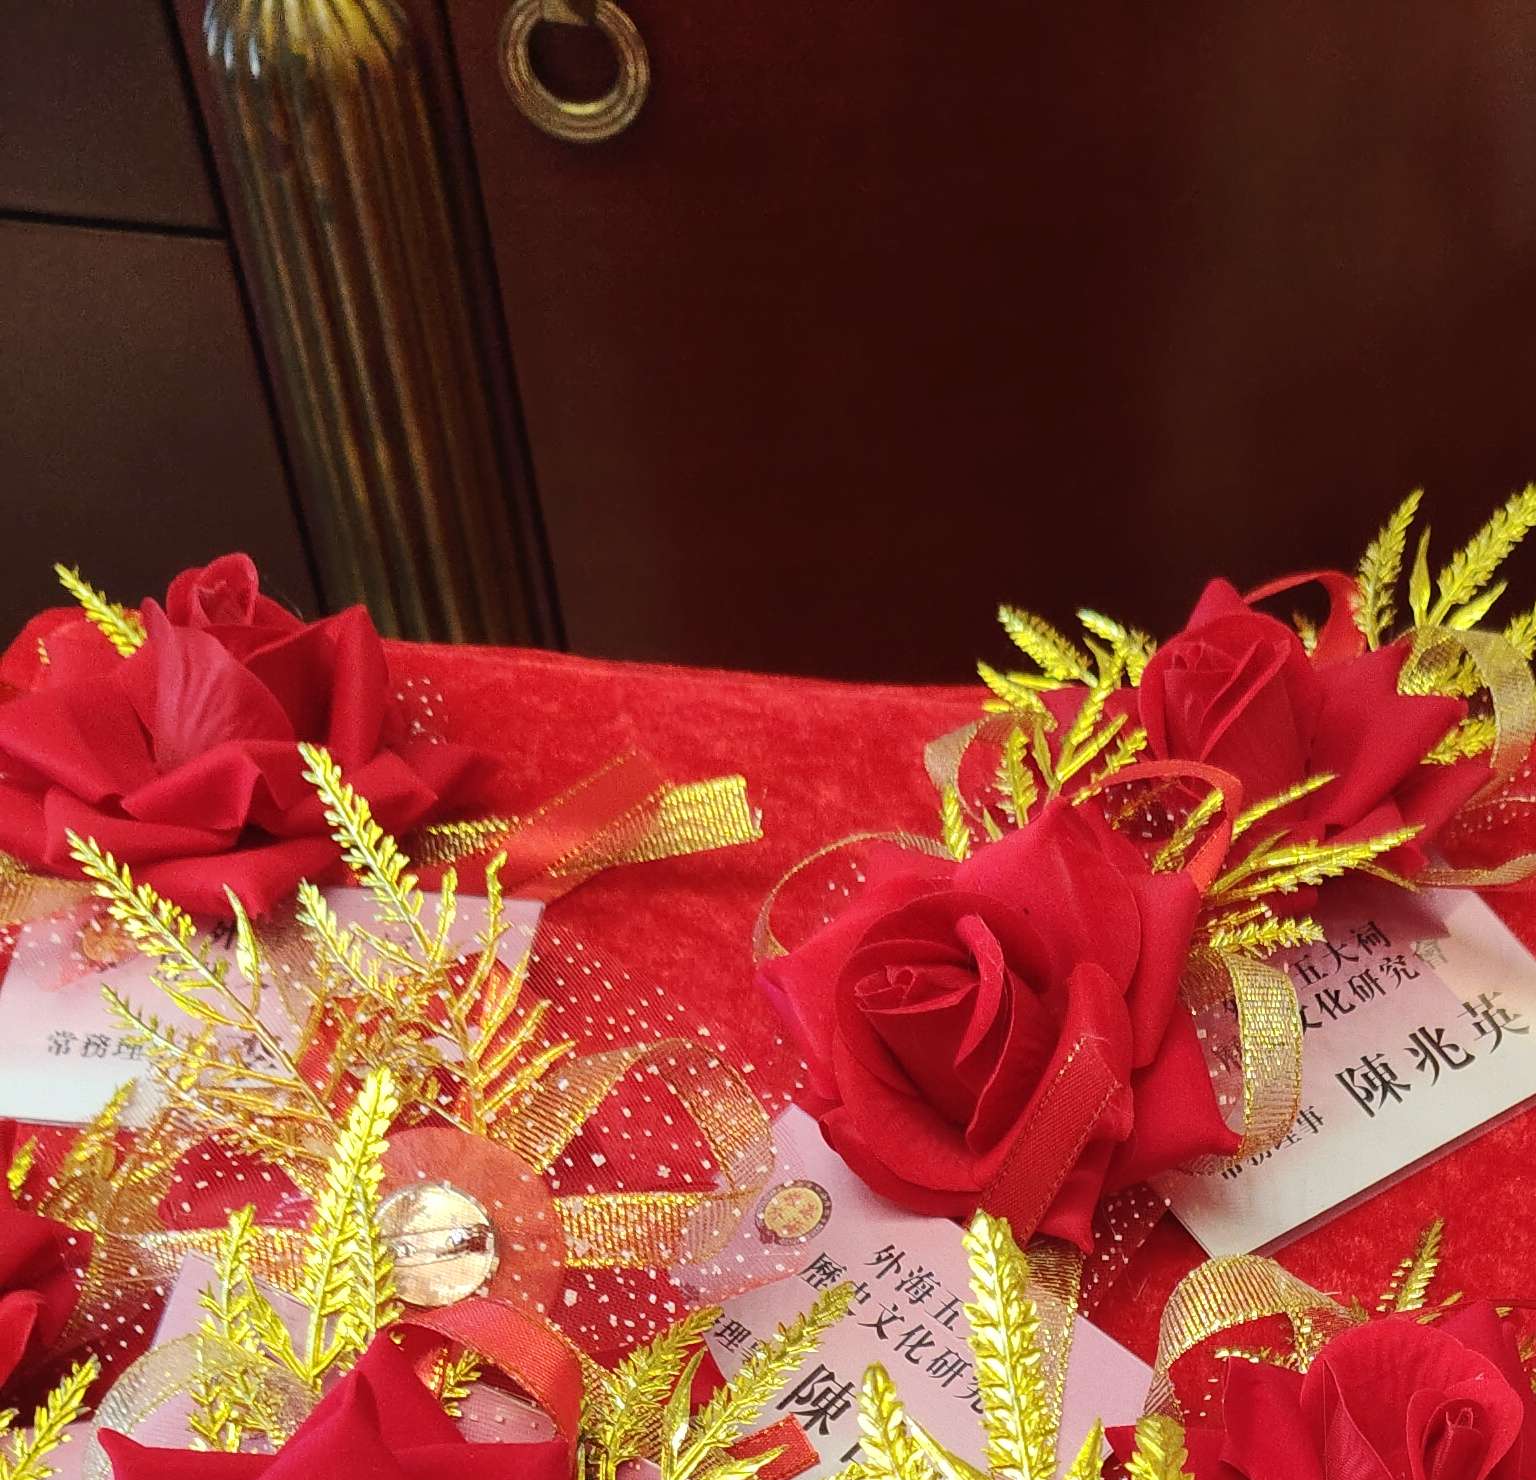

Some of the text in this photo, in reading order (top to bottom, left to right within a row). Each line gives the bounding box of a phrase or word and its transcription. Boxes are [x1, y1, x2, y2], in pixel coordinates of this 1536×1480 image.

[1335, 991, 1530, 1118] 陳兆英
[863, 1244, 968, 1339] 外海五
